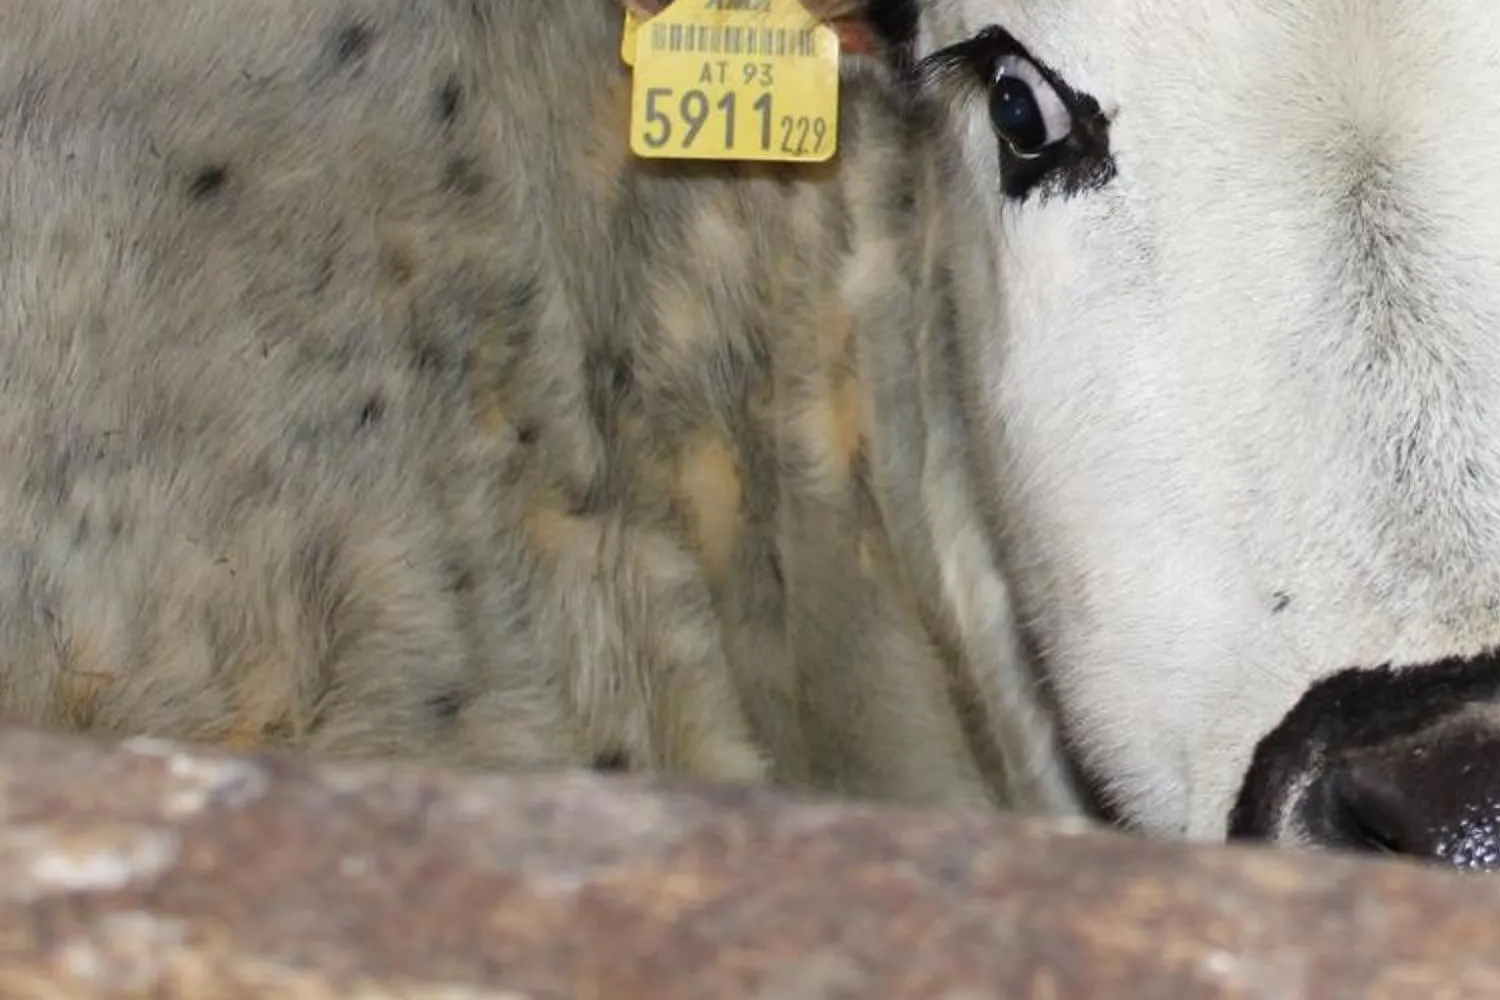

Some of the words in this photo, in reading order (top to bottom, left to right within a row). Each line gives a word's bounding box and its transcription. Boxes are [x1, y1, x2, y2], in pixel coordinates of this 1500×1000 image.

[699, 61, 730, 84] AT
[743, 62, 774, 86] 93
[642, 87, 773, 150] 5911
[780, 114, 827, 155] 229
